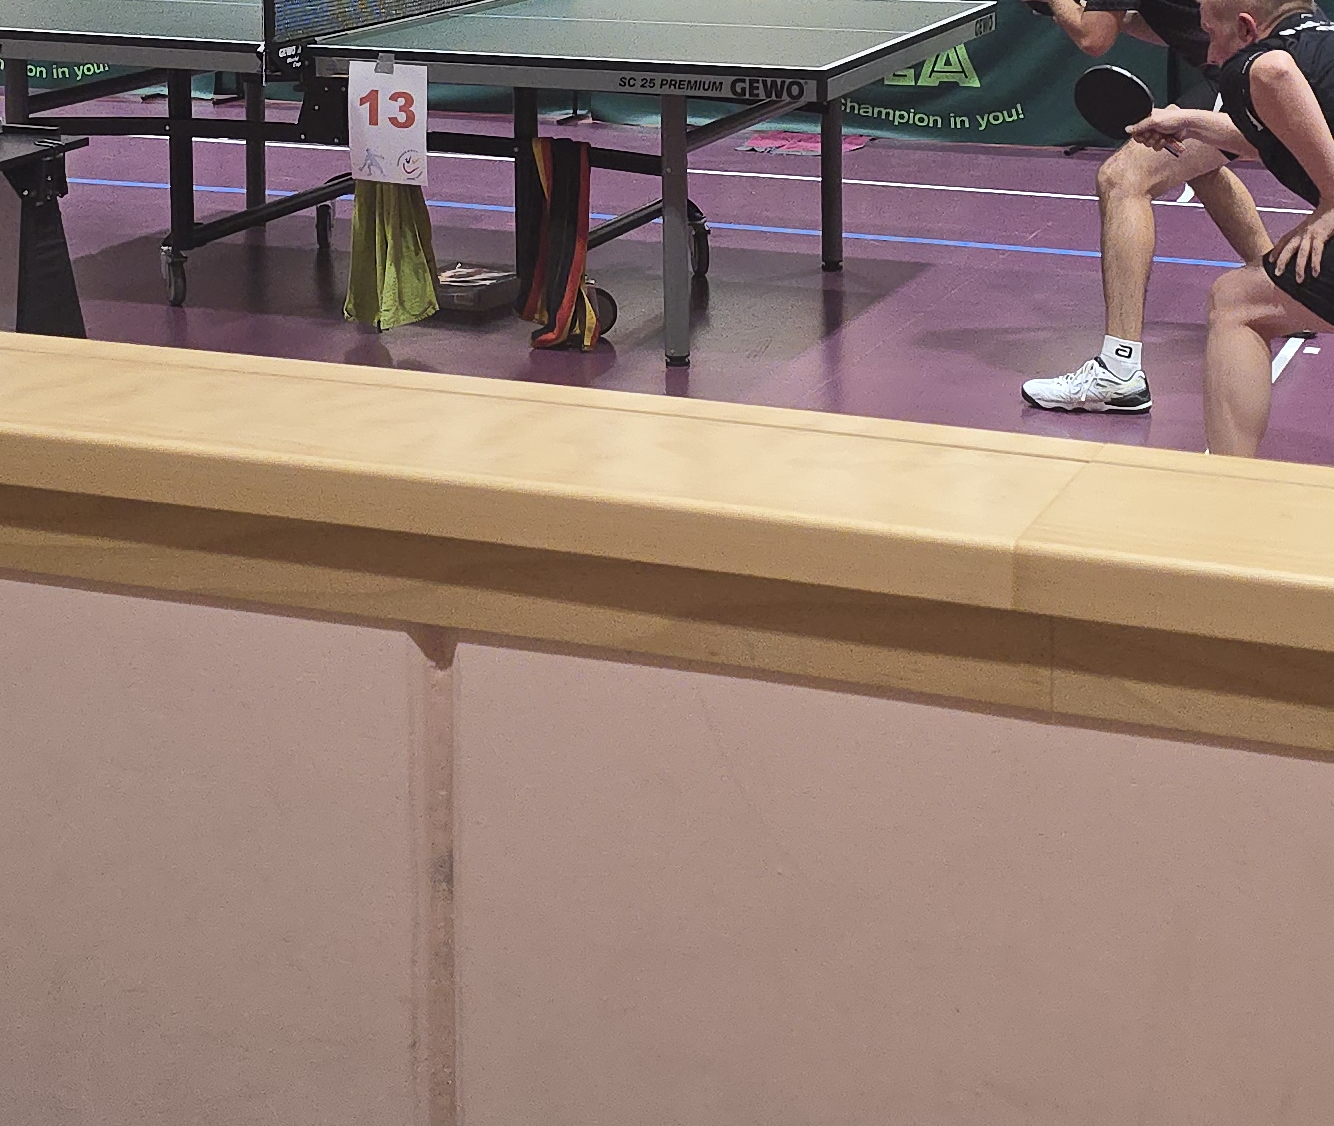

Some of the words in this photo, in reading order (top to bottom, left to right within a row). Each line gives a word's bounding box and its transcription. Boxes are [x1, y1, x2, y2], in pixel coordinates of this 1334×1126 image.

[53, 65, 69, 79] in
[619, 76, 637, 88] SC
[639, 77, 656, 90] 25
[659, 78, 723, 93] PREMIUM
[730, 77, 806, 101] GEWO
[359, 89, 416, 129] 13
[950, 113, 970, 129] in
[976, 103, 1025, 131] you!
